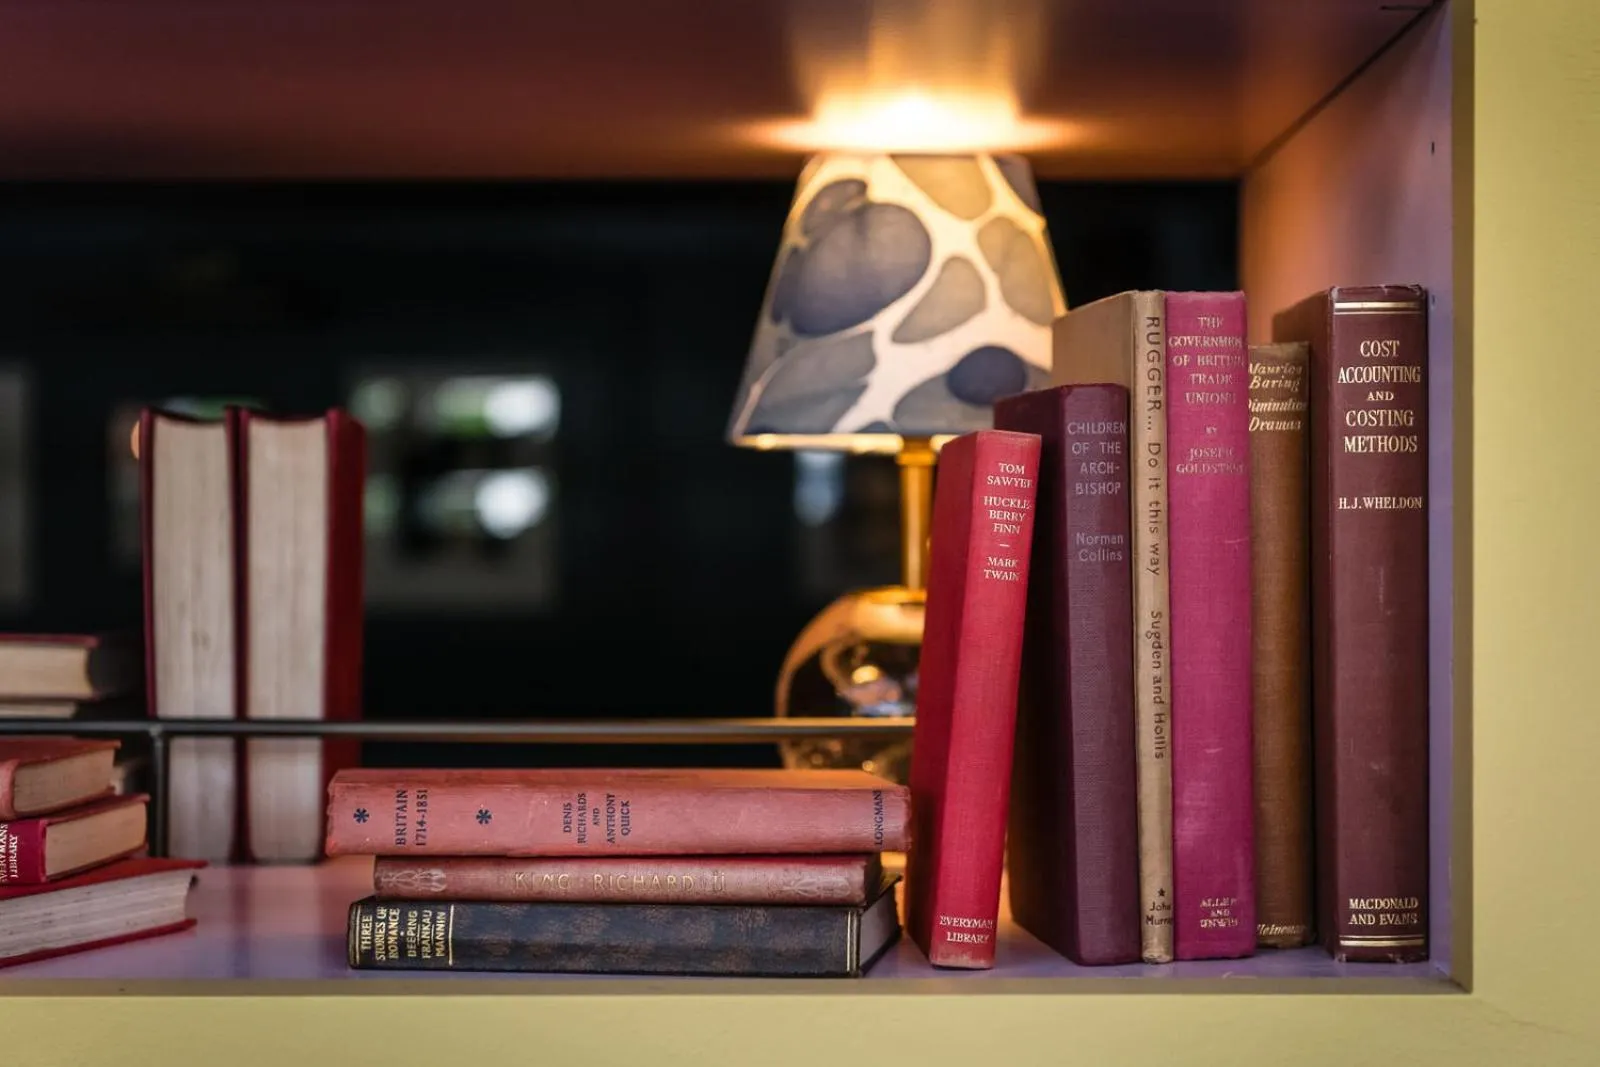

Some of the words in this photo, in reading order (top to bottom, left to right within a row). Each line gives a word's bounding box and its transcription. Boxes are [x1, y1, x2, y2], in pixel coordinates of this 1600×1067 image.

[1168, 335, 1243, 347] GOVERNMEN
[1360, 340, 1400, 357] COST
[1173, 354, 1190, 366] OF
[1249, 375, 1301, 392] Baring
[1337, 366, 1421, 384] ACCOUNTING
[1366, 391, 1394, 401] AND
[1345, 410, 1414, 427] COSTING
[1067, 422, 1127, 436] CHILDREN
[1071, 441, 1090, 455] OF
[1100, 441, 1122, 454] THE
[1343, 435, 1418, 453] METHODS
[1147, 442, 1161, 468] Do
[999, 463, 1025, 475] TOM
[1080, 462, 1121, 475] ARCH-
[1075, 482, 1122, 495] BISHOP
[1148, 477, 1161, 490] it
[988, 509, 1026, 522] BERRY
[1149, 501, 1162, 534] this
[993, 523, 1021, 534] FINN
[1076, 532, 1124, 545] Norman
[988, 556, 1018, 568] MARK
[1079, 549, 1123, 562] Collins
[1146, 542, 1160, 576] way
[983, 569, 1019, 581] TWAIN
[1145, 611, 1163, 669] Sugden
[1152, 675, 1165, 705] and
[1153, 713, 1167, 760] Hollis
[395, 789, 408, 846] BRITAIN
[415, 789, 428, 846] 1714-1851
[563, 802, 573, 833] DENIS
[577, 792, 587, 844] RICHARDS
[592, 807, 600, 827] AND
[606, 793, 616, 844] ANTHONY
[620, 800, 632, 836] QUICK
[9, 833, 19, 878] LIBRARY
[514, 873, 570, 891] KING
[593, 875, 695, 892] RICHARD
[1349, 898, 1419, 910] MACDONALD
[939, 915, 993, 929] EVERYMAN
[1348, 913, 1376, 925] AND
[1380, 913, 1418, 925] EVANS
[361, 914, 373, 950] THREE
[375, 921, 387, 961] STORIES
[388, 907, 400, 959] ROMANCE
[406, 910, 418, 957] DEEPING
[421, 909, 433, 959] FRANKAU
[435, 911, 447, 957] MANNIN
[946, 931, 990, 944] LIBRARY
